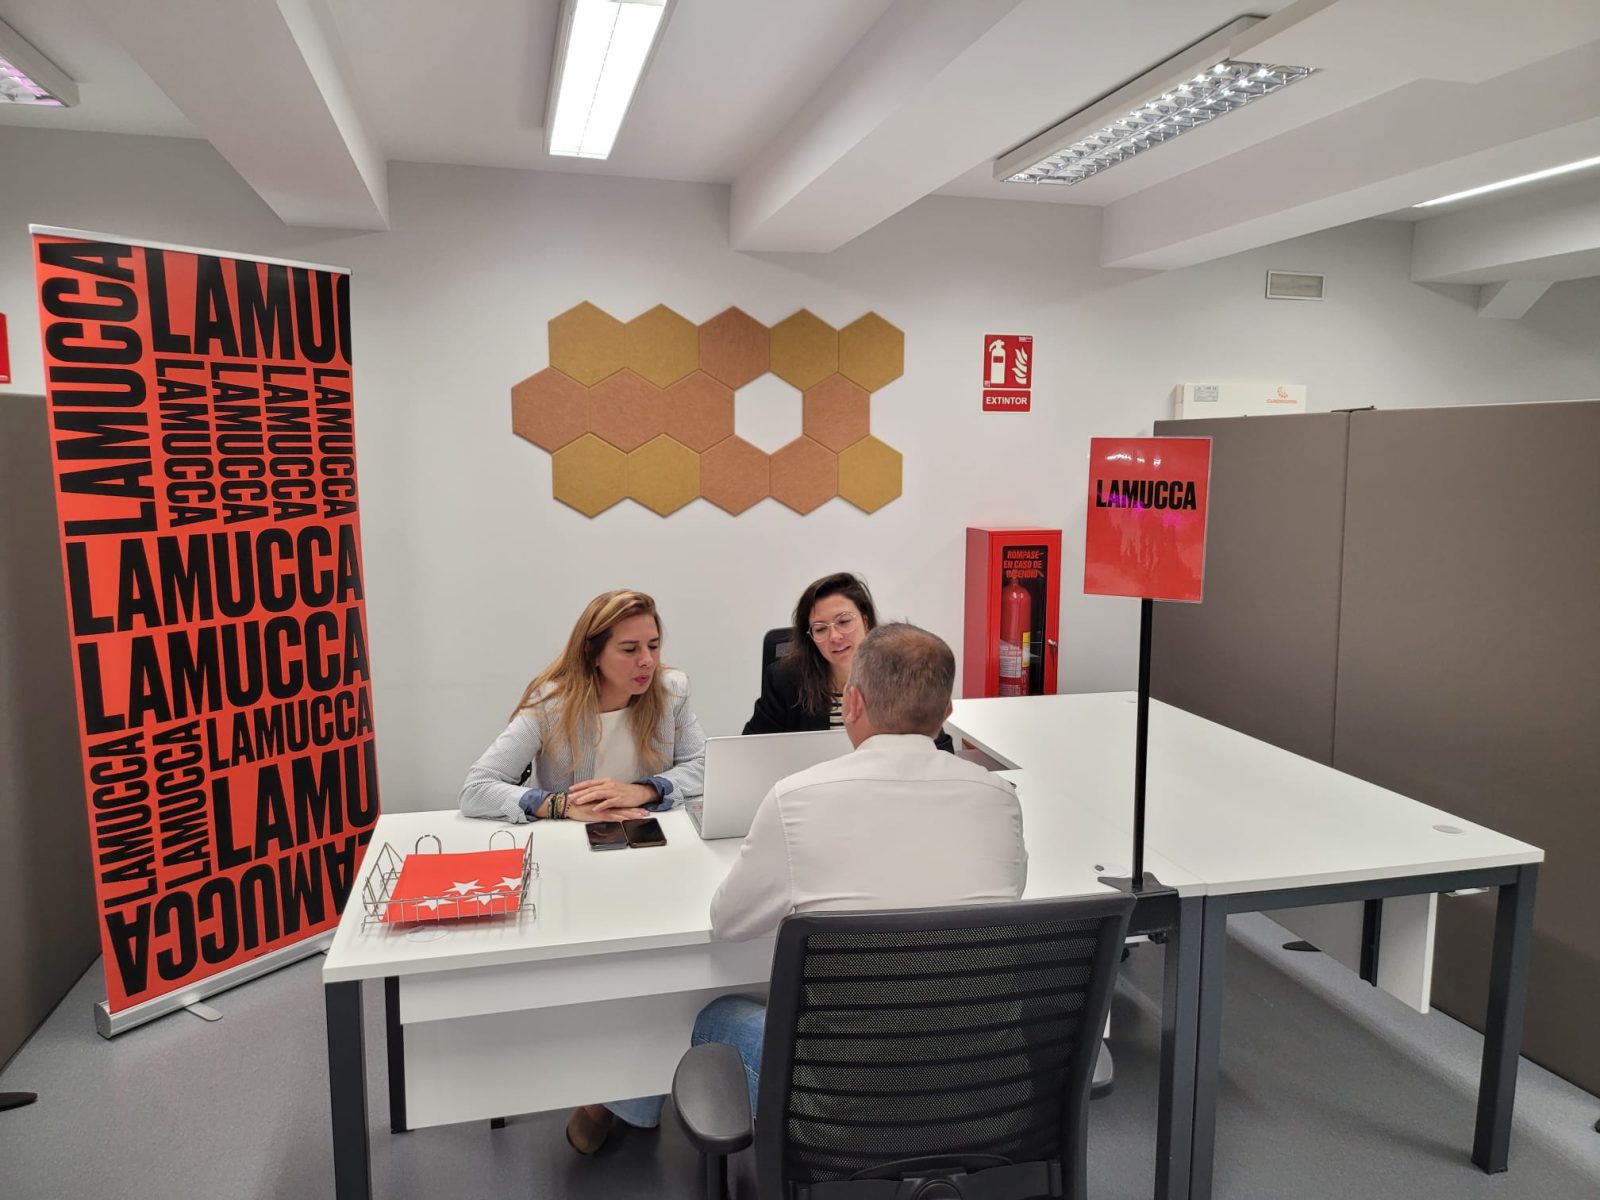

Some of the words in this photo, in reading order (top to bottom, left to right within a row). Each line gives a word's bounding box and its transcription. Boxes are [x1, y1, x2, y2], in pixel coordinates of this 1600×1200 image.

[39, 242, 158, 536] LAMUCCA
[155, 358, 217, 528] LAMUCCA
[210, 361, 269, 525] LAMUCCA
[261, 364, 318, 522] LAMUCCA
[312, 367, 357, 519] LAMUCCA
[985, 396, 1028, 405] EXTINTOR
[1003, 560, 1013, 569] EN
[1014, 560, 1032, 569] CASO
[1033, 560, 1042, 569] DE
[1095, 479, 1197, 510] LAMUCCA
[65, 524, 364, 636] LAMUCCA
[78, 607, 370, 736] LAMUCCA
[206, 686, 373, 772] LAMUCCA
[89, 731, 158, 908] LAMUCCA
[152, 719, 212, 890] LAMUCCA
[211, 740, 380, 870] LAMU
